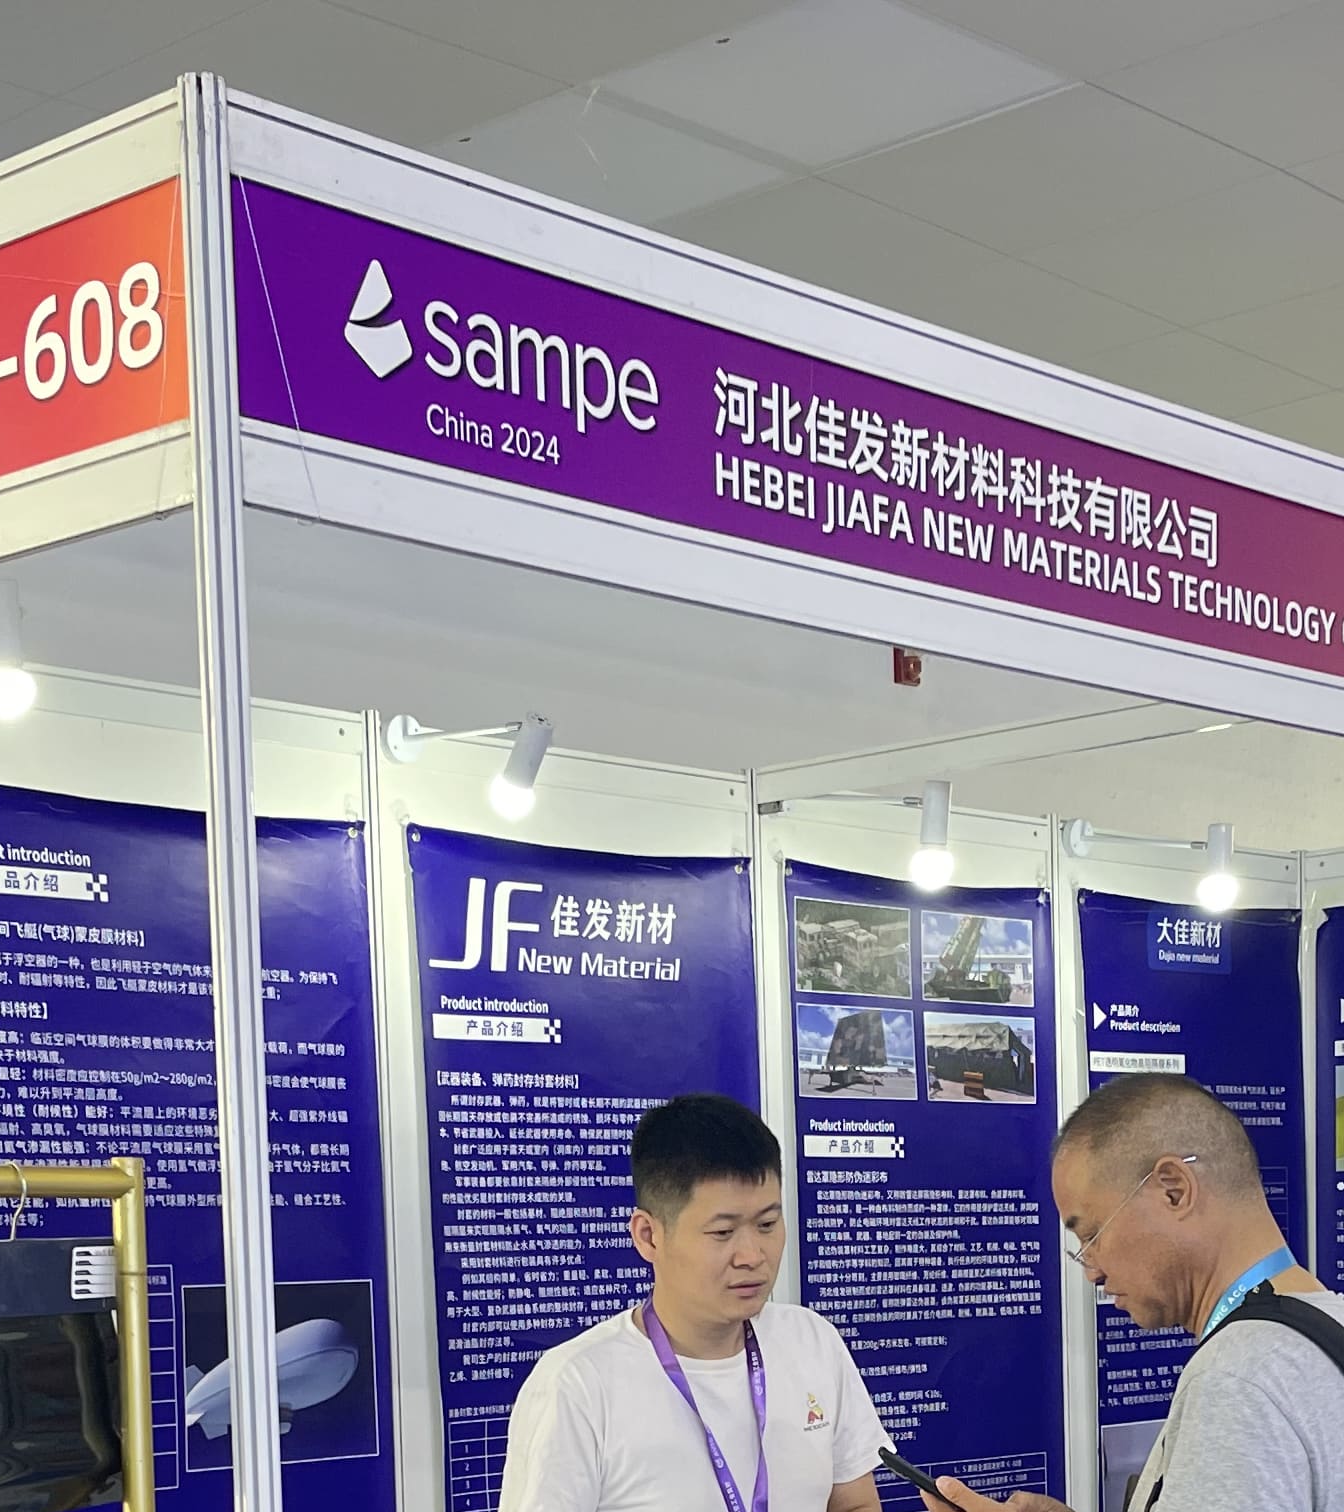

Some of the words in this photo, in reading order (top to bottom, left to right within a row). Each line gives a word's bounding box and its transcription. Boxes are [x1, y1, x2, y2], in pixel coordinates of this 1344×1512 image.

[423, 300, 660, 433] sampe
[425, 403, 494, 450] China
[500, 421, 561, 466] 2024
[712, 366, 1219, 568] 河北佳发新材料科技有限公司
[714, 452, 816, 519] HEBEI
[820, 484, 916, 546] JIAFA
[922, 507, 996, 564] NEW
[1002, 528, 1163, 605] MATERIALS
[1167, 570, 1336, 646] TECHNOLOGY
[6, 842, 92, 868] introduction
[428, 877, 544, 972] JF
[550, 894, 677, 945] 佳发新材
[1156, 917, 1222, 949] 大佳新材
[517, 946, 573, 974] New
[579, 951, 681, 982] Material
[440, 995, 483, 1012] Product
[483, 997, 549, 1014] introduction
[465, 1019, 524, 1038] 产品介绍
[1110, 1020, 1140, 1032] Product
[1140, 1020, 1181, 1034] description
[809, 1118, 842, 1132] Product
[842, 1119, 895, 1133] introduction
[828, 1139, 875, 1154] 产品介绍
